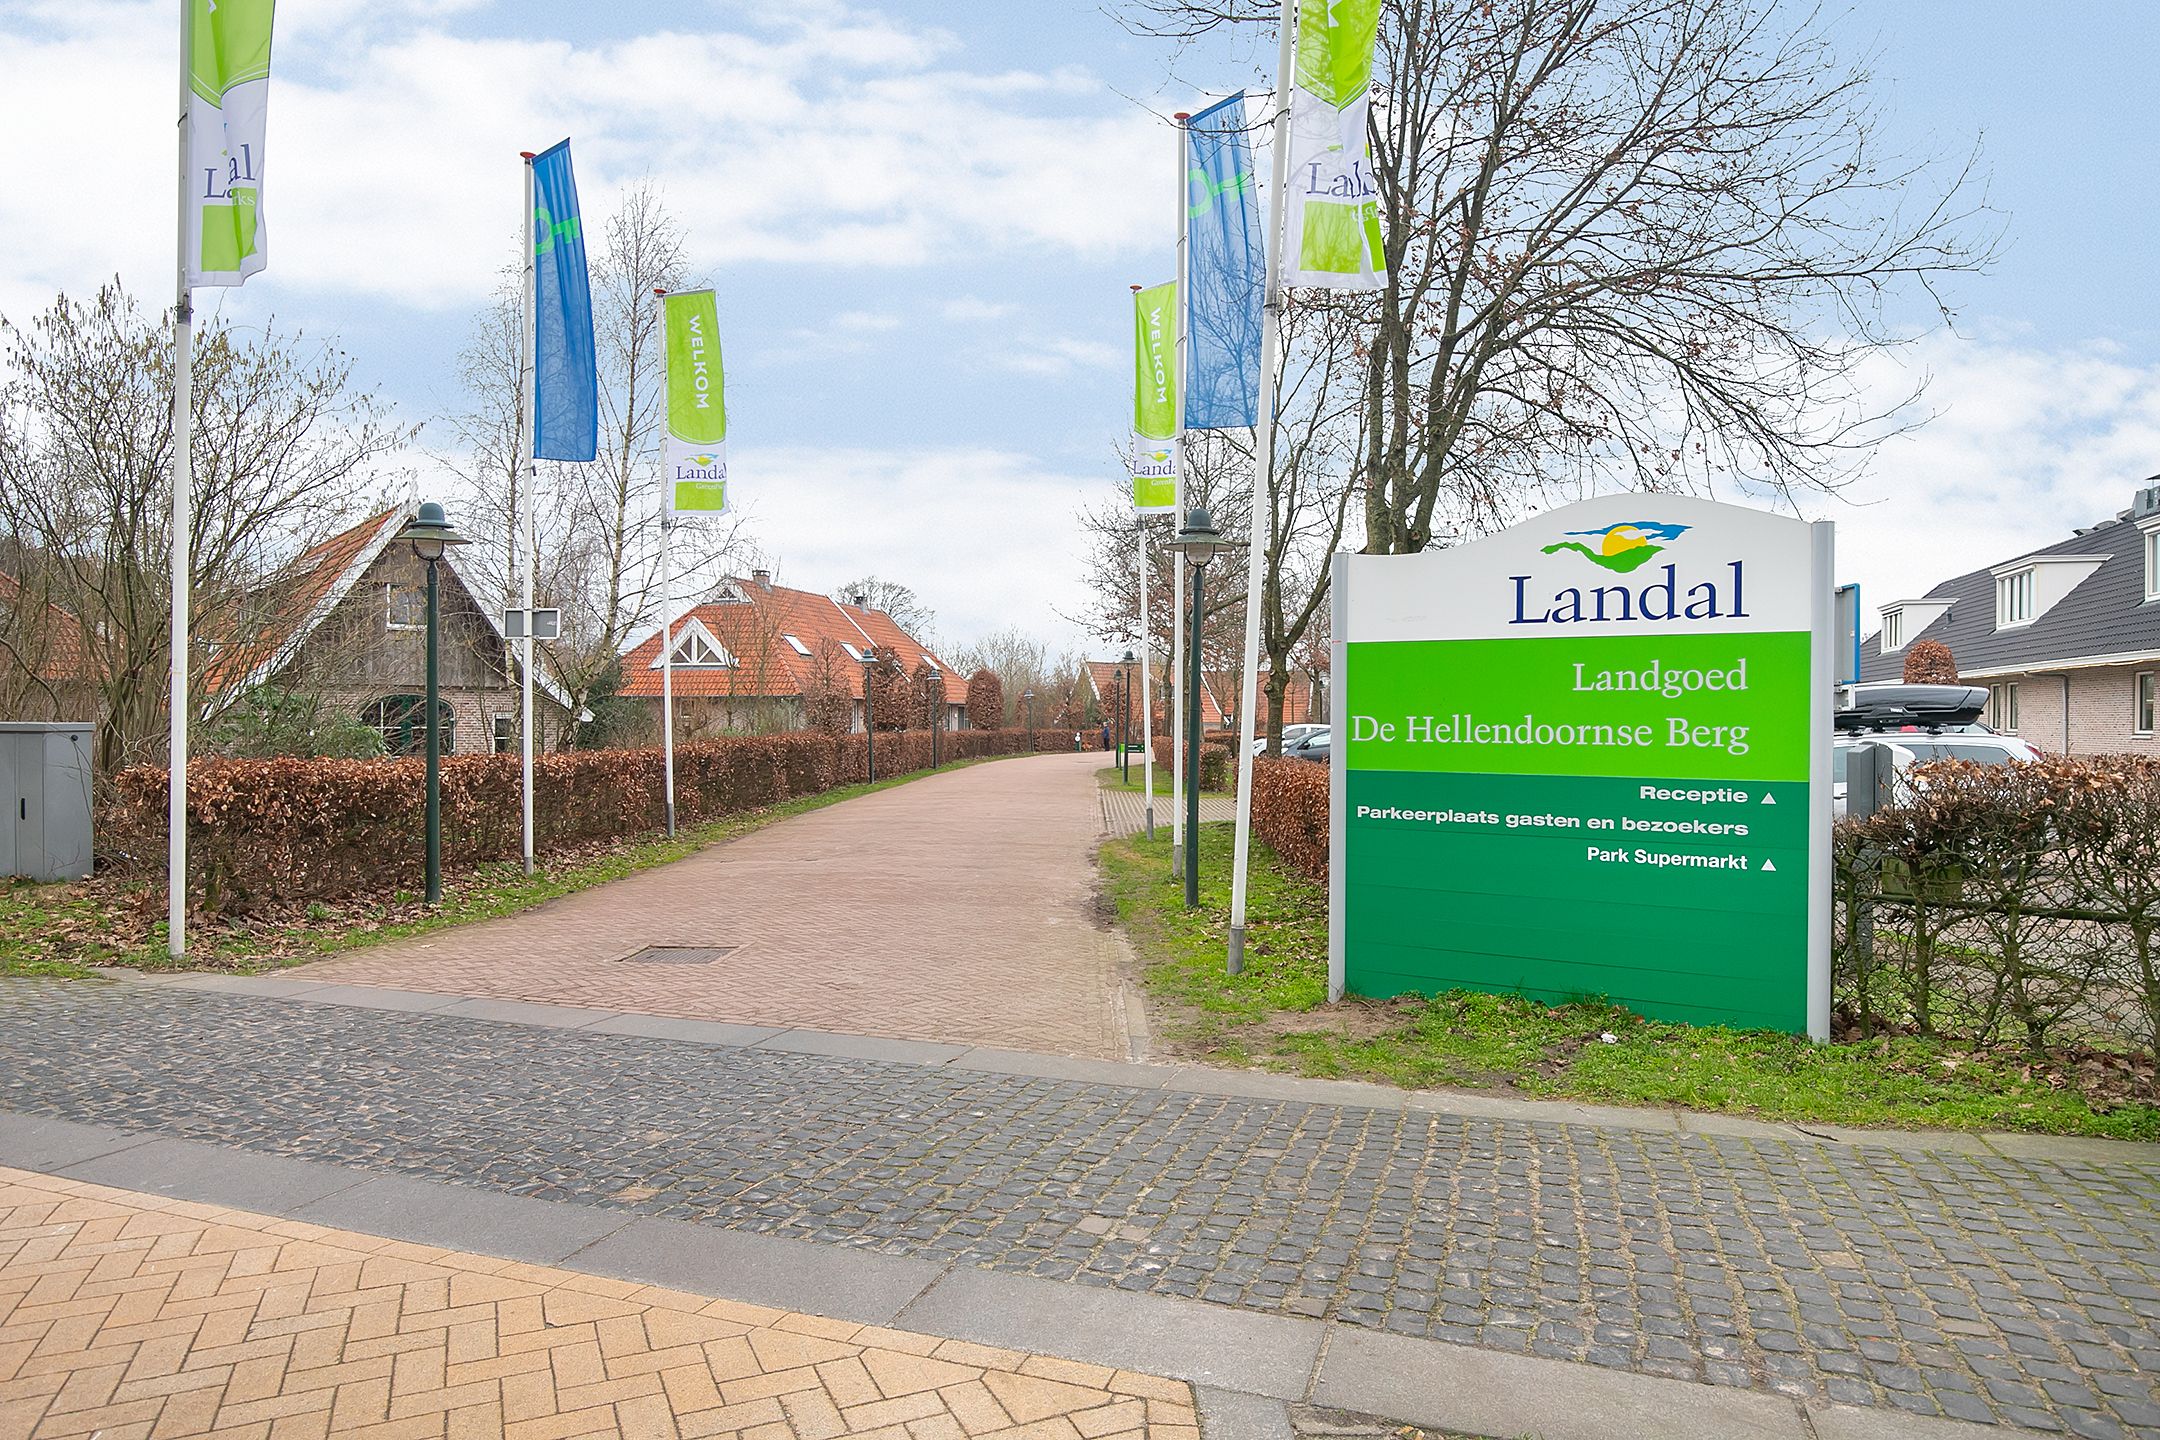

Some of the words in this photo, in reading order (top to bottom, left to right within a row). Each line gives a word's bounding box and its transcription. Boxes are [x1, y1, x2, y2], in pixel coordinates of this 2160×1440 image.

[688, 314, 710, 409] WELKOM
[1150, 307, 1167, 403] WELKOM
[1133, 459, 1177, 475] Landa
[1508, 560, 1750, 625] Landal
[1572, 658, 1748, 699] Landgoed
[1352, 715, 1395, 742] De
[1406, 715, 1653, 747] Hellendoornse
[1665, 717, 1750, 756] Berg
[1640, 785, 1748, 805] Receptie
[1357, 805, 1500, 826] Parkeerplaats
[1505, 812, 1580, 831] gasten
[1587, 817, 1615, 830] en
[1621, 816, 1749, 836] bezoekers
[1587, 846, 1630, 863] Park
[1634, 848, 1748, 870] Supermarkt
